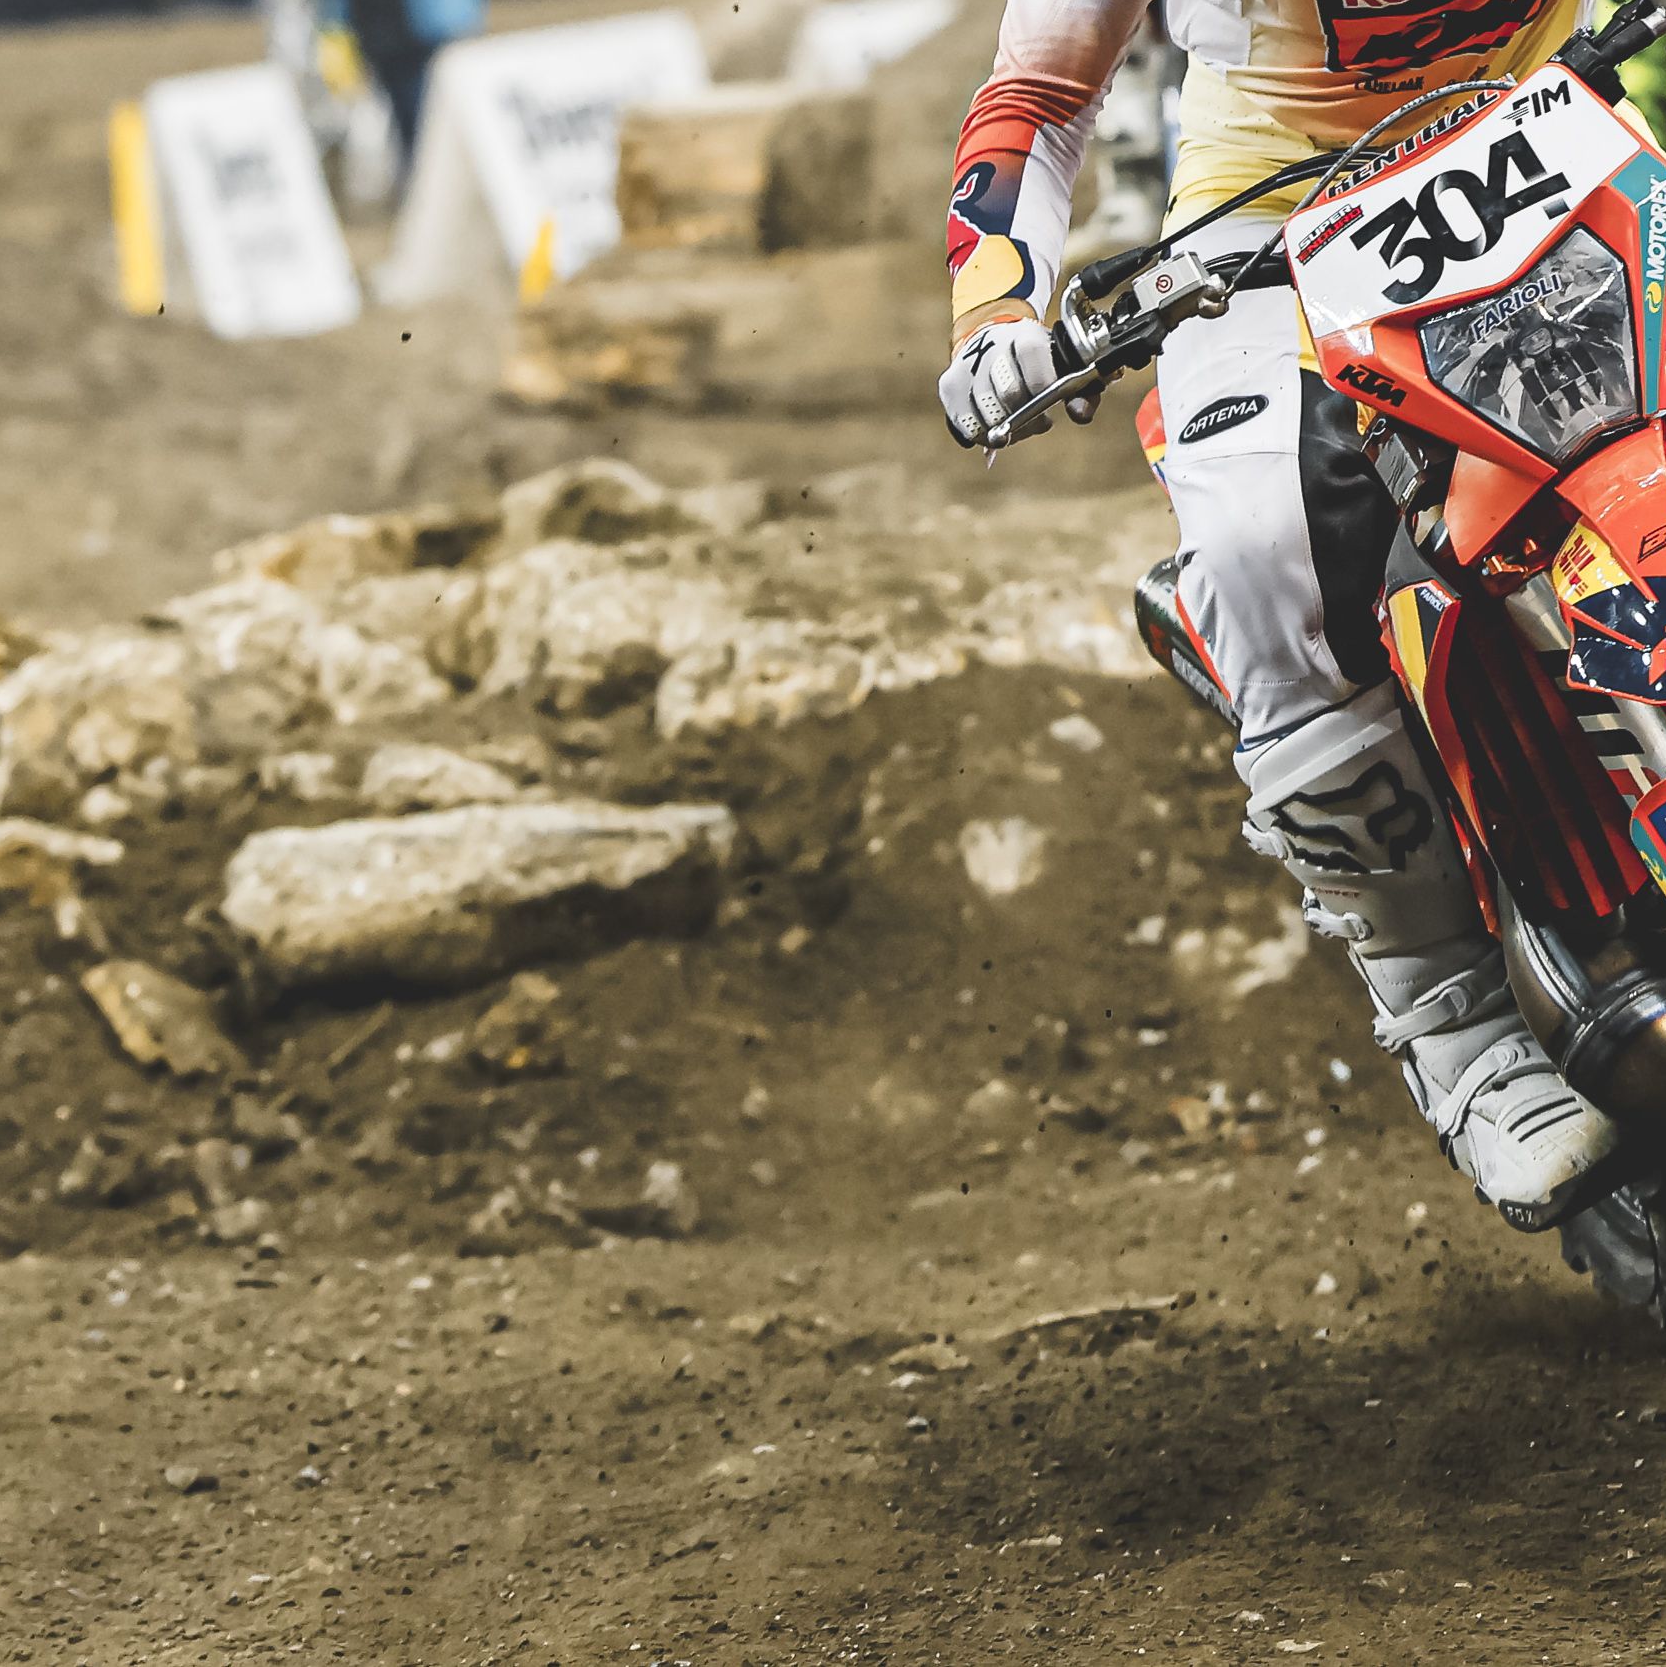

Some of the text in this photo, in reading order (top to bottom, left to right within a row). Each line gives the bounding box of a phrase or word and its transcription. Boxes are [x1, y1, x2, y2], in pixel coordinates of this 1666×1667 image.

[1502, 80, 1572, 125] FIM
[1298, 203, 1353, 251] SUPER
[1349, 130, 1571, 305] 304
[1472, 274, 1561, 338] FARIOLI
[1335, 362, 1407, 408] KTM
[1183, 399, 1259, 439] ORTEMA
